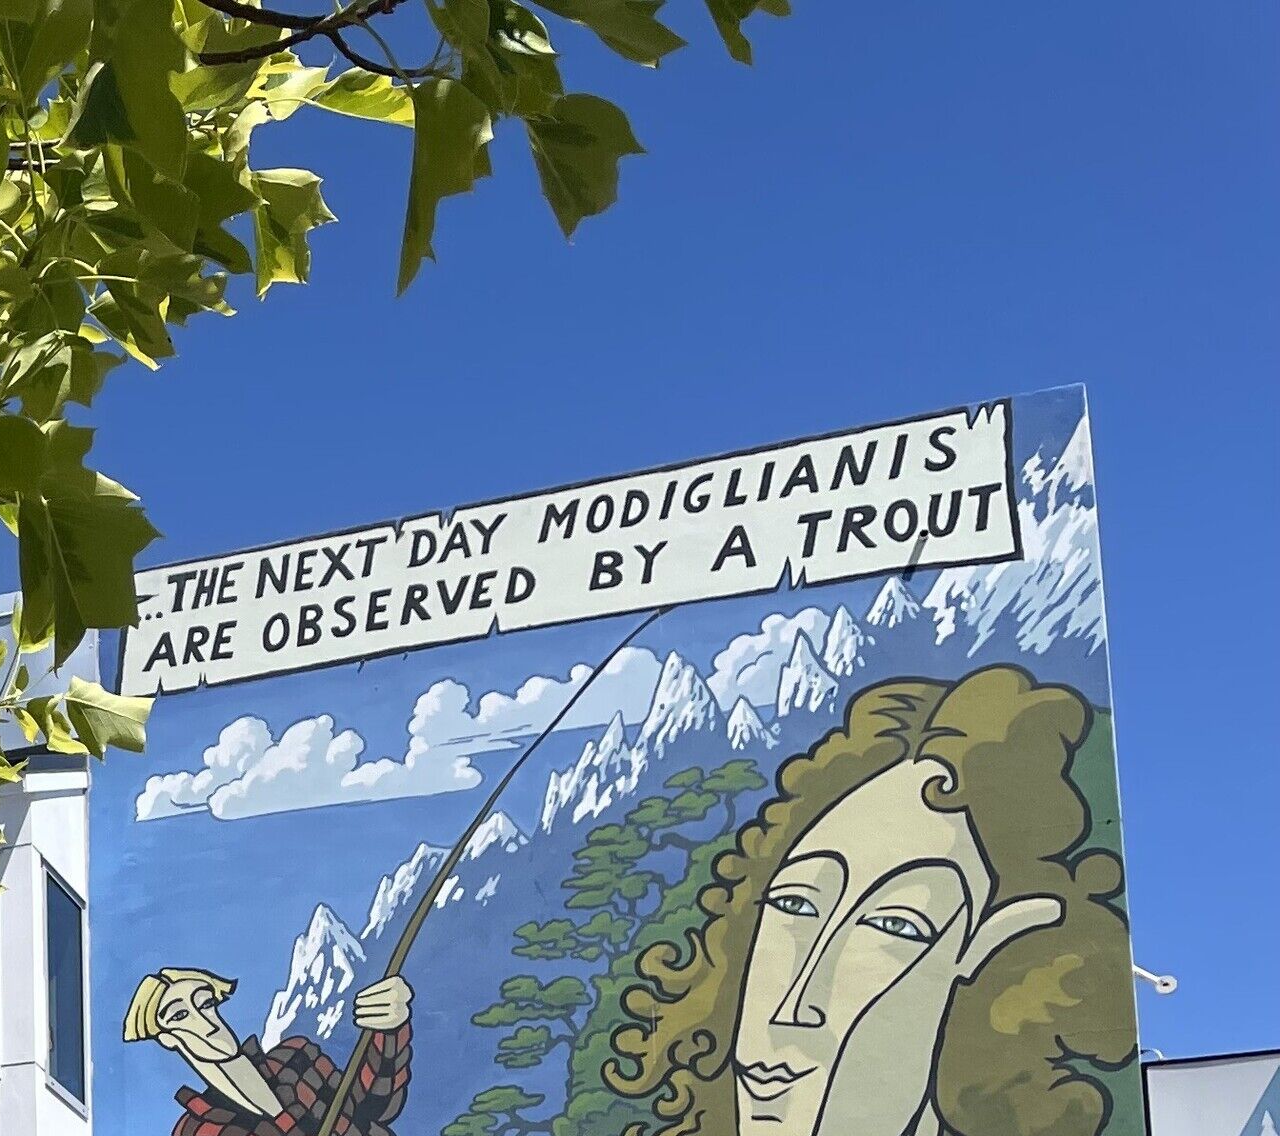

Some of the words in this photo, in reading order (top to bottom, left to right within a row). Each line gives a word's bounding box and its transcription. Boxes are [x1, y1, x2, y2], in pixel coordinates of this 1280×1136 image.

[138, 560, 245, 622] ..THE
[255, 535, 388, 600] NEXT
[406, 512, 508, 569] DAY
[537, 426, 958, 544] MODIGLIANIS
[142, 619, 238, 673] ARE
[262, 565, 537, 653] OBSERVED
[588, 539, 669, 591] BY
[710, 524, 757, 572] A
[796, 482, 1003, 559] TROUT
